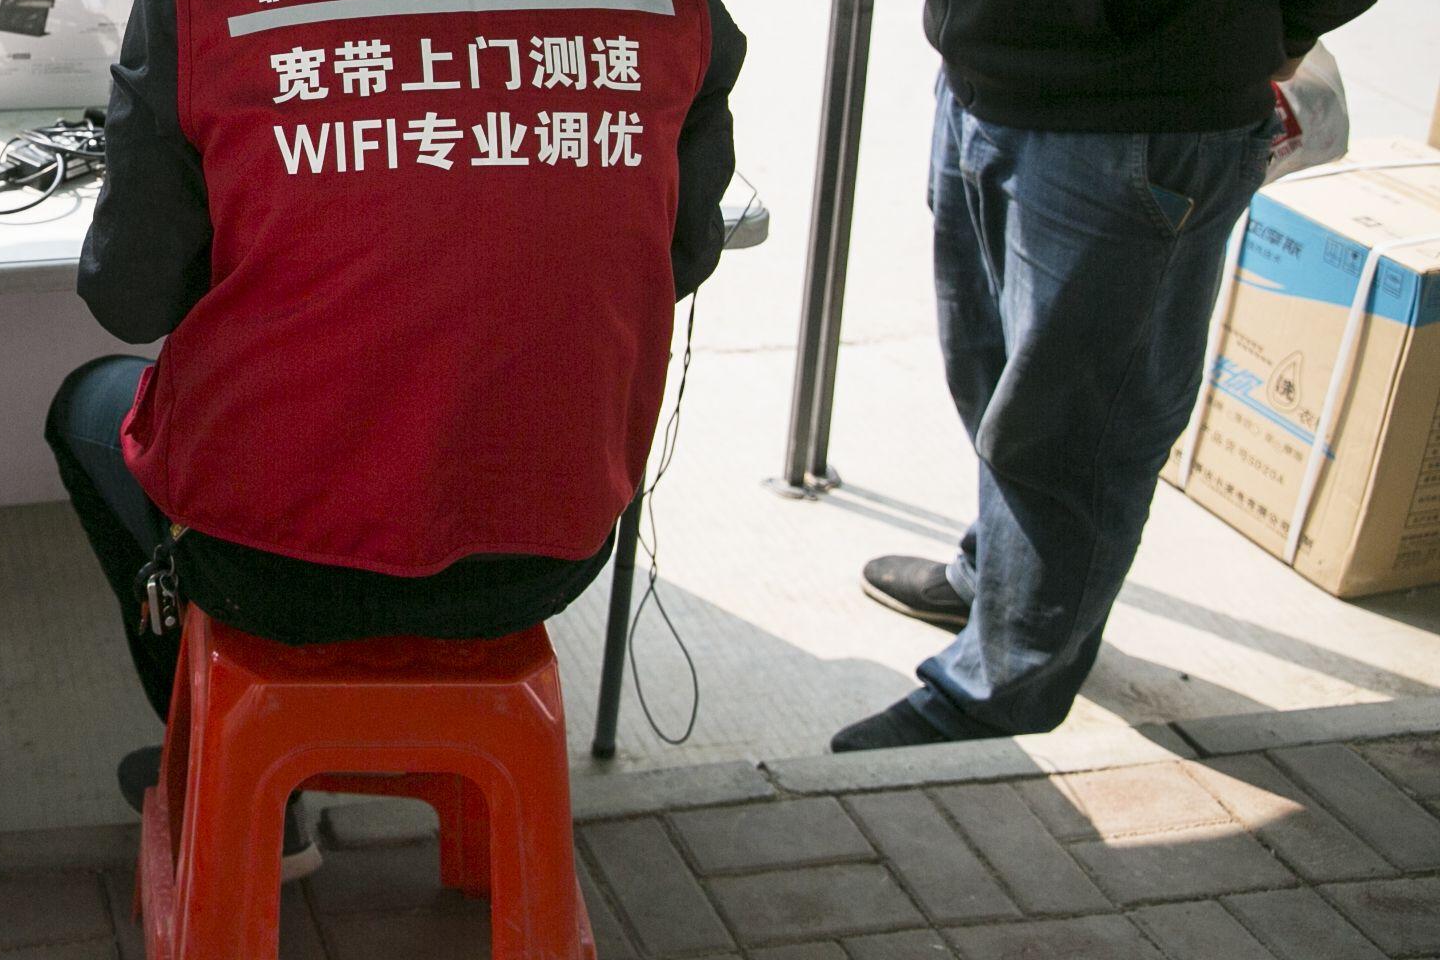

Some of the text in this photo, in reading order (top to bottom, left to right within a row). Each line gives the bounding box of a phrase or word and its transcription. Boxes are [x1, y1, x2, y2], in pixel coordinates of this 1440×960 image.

[270, 35, 642, 104] 宽带上门测速
[273, 110, 644, 175] WIFI专业调优
